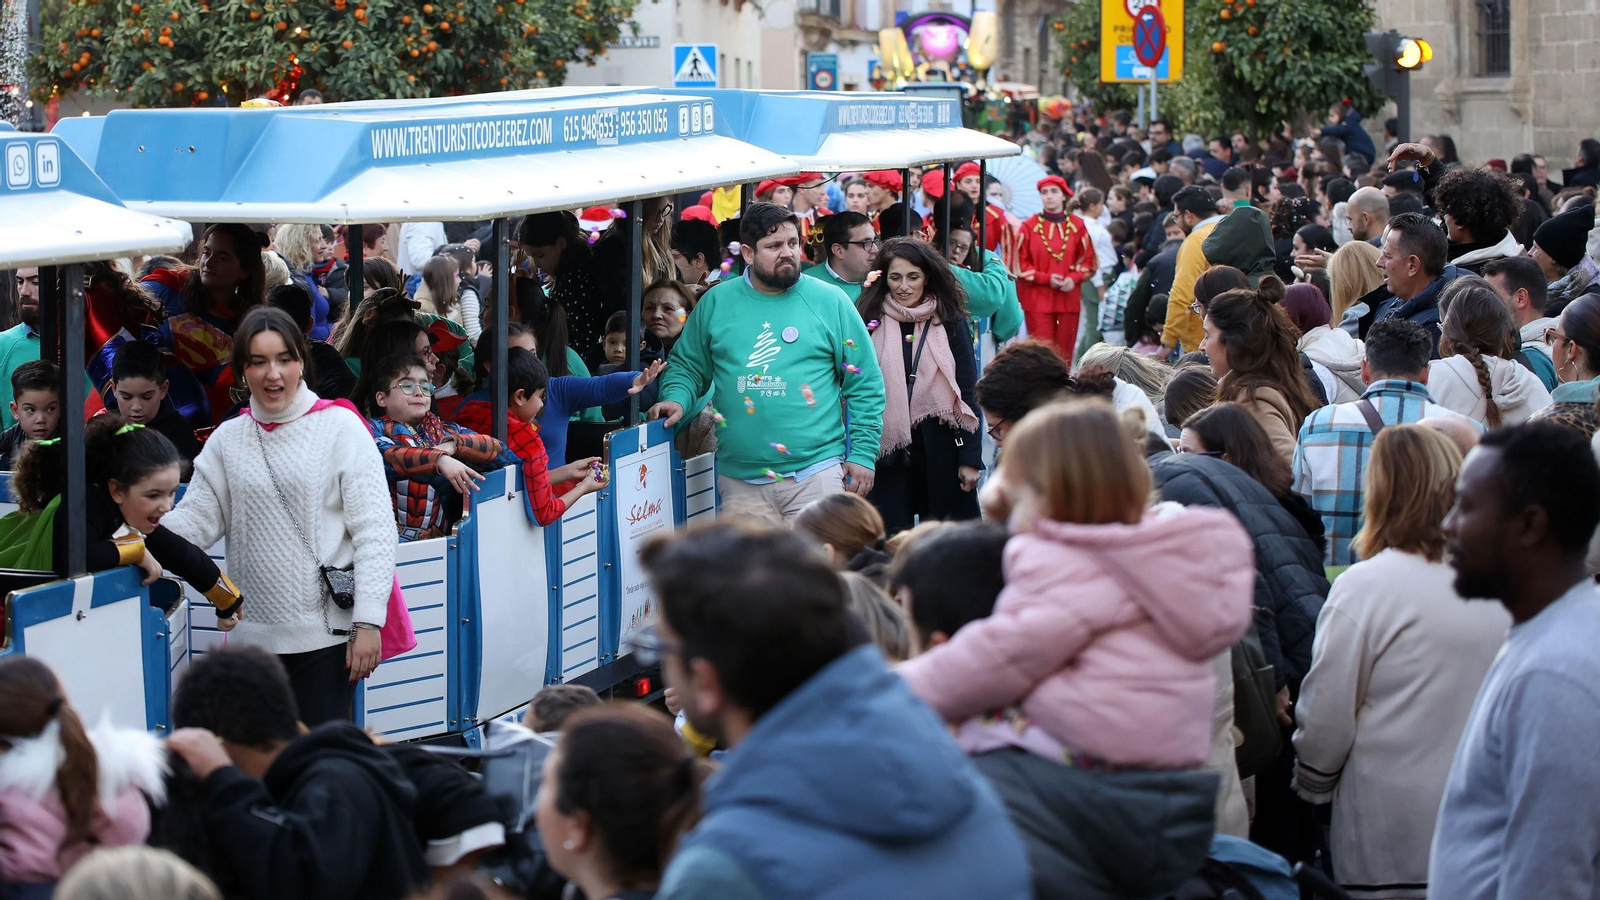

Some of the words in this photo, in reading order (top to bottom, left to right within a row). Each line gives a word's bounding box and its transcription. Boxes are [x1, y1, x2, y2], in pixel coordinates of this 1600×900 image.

[371, 117, 553, 159] WWW.TRENTURISTICODEJEREZ.COM
[563, 114, 580, 142] 615
[581, 113, 597, 141] 948
[598, 112, 614, 138] 653
[620, 110, 636, 137] 956
[637, 109, 652, 135] 350
[653, 108, 668, 133] 056
